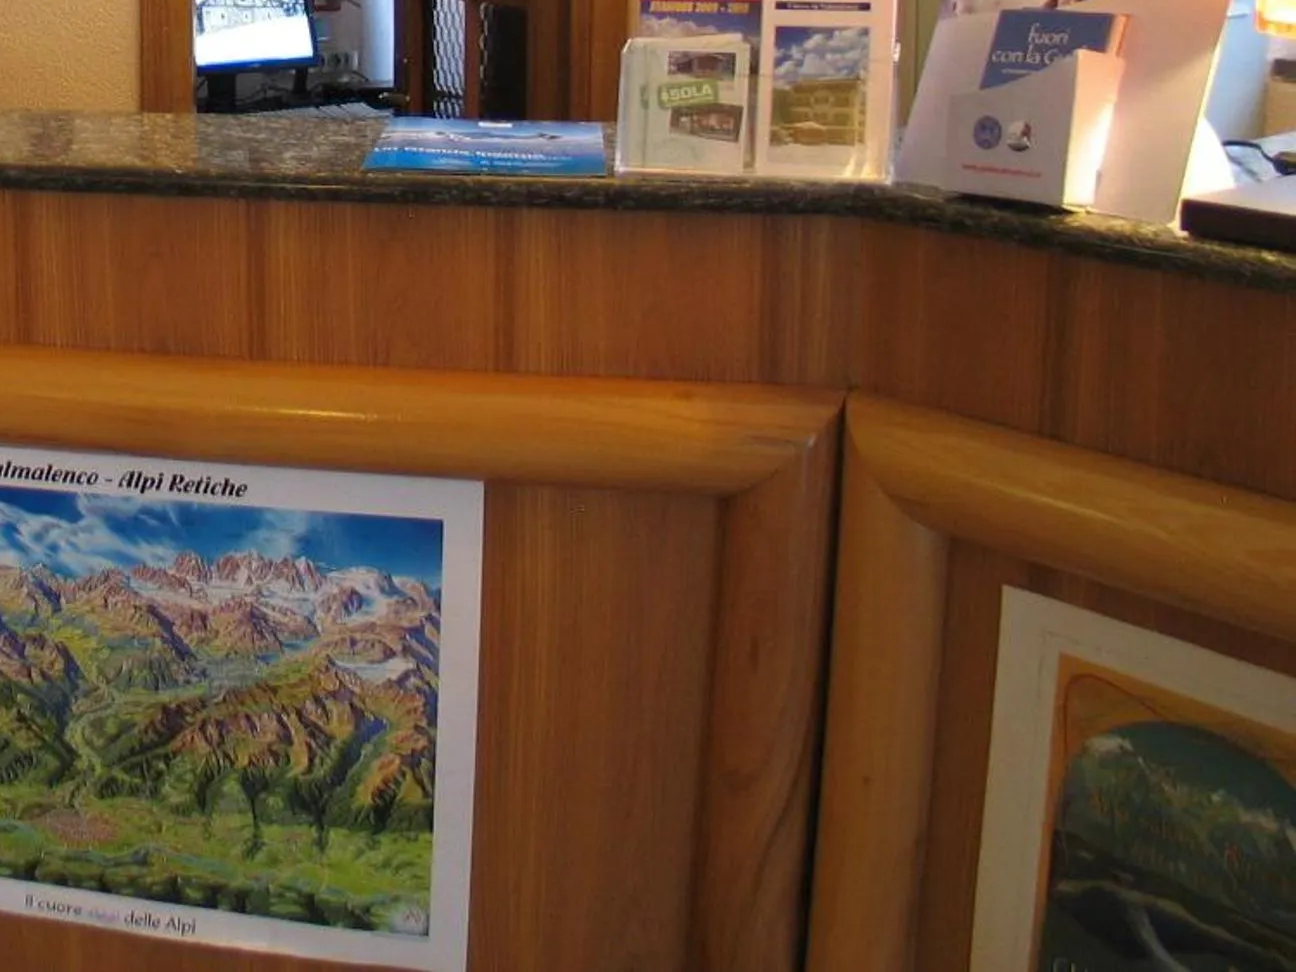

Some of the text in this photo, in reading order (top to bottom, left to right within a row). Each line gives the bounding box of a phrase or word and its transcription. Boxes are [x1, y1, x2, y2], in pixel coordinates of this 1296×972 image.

[1027, 22, 1070, 45] fuori
[991, 49, 1023, 63] con
[1025, 44, 1042, 64] la
[118, 470, 164, 495] Alpi
[168, 473, 249, 498] Retiche
[37, 900, 83, 916] cuore
[123, 909, 162, 928] delle
[165, 916, 197, 936] Alpi
